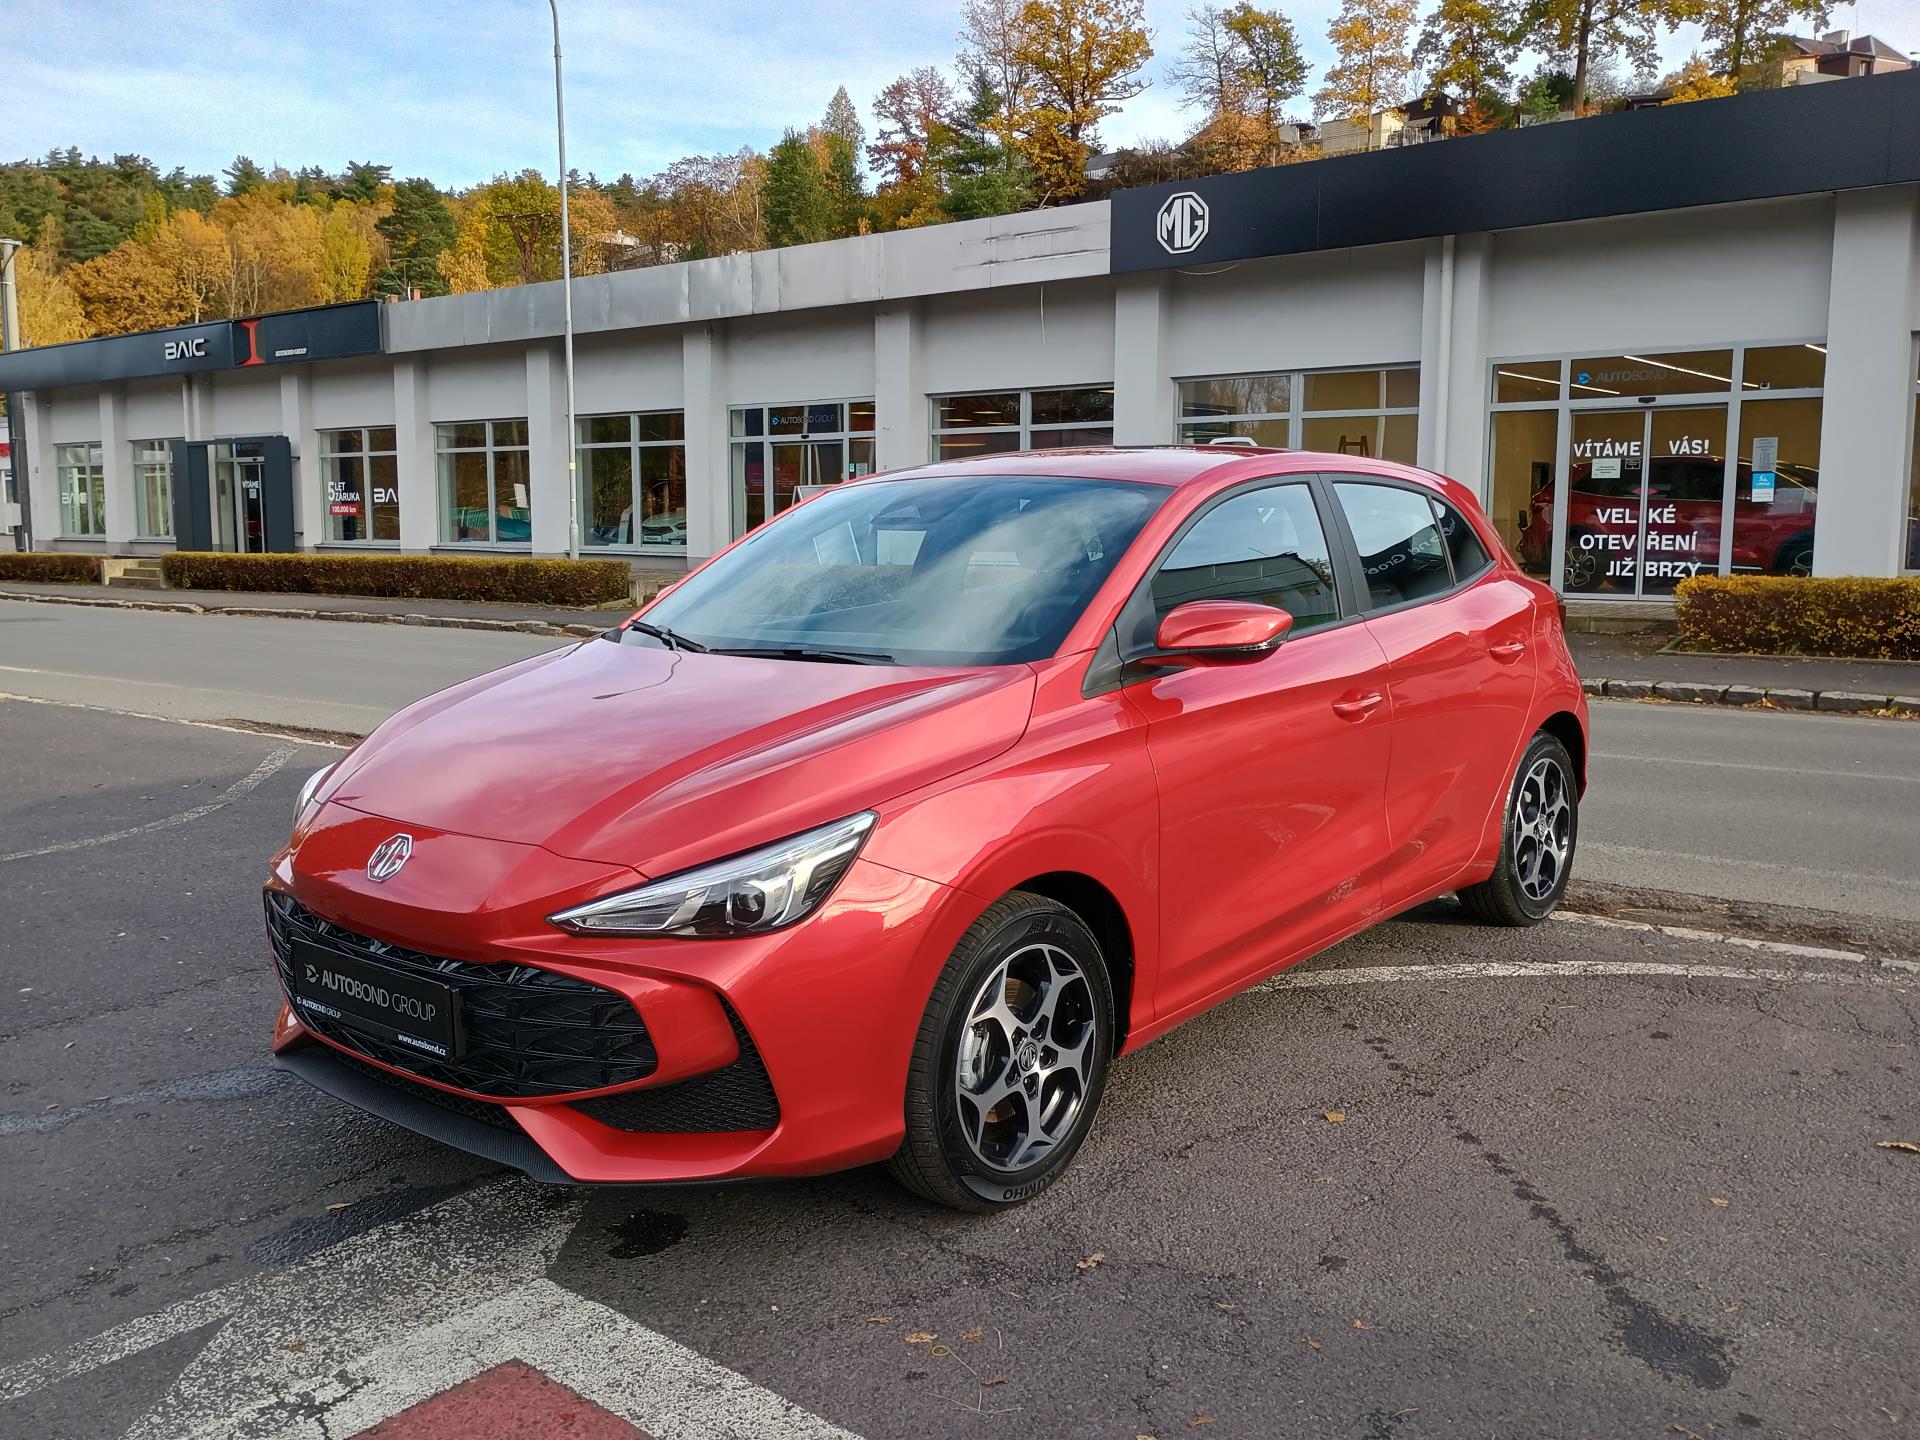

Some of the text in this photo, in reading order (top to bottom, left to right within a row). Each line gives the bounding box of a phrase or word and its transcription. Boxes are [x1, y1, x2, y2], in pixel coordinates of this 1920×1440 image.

[1160, 195, 1205, 250] MG
[164, 338, 206, 360] BAIC
[1596, 369, 1667, 383] AUTOBOND
[1573, 435, 1710, 458] VÍTÁME VÁS!
[327, 481, 346, 502] 5 LET
[1605, 557, 1702, 578] JIŽ BRZY
[370, 836, 410, 879] MG
[302, 998, 327, 1014] AUTOBOND
[321, 969, 436, 1022] AUTOBOND GROUP
[397, 1033, 447, 1056] www.autobond.cz
